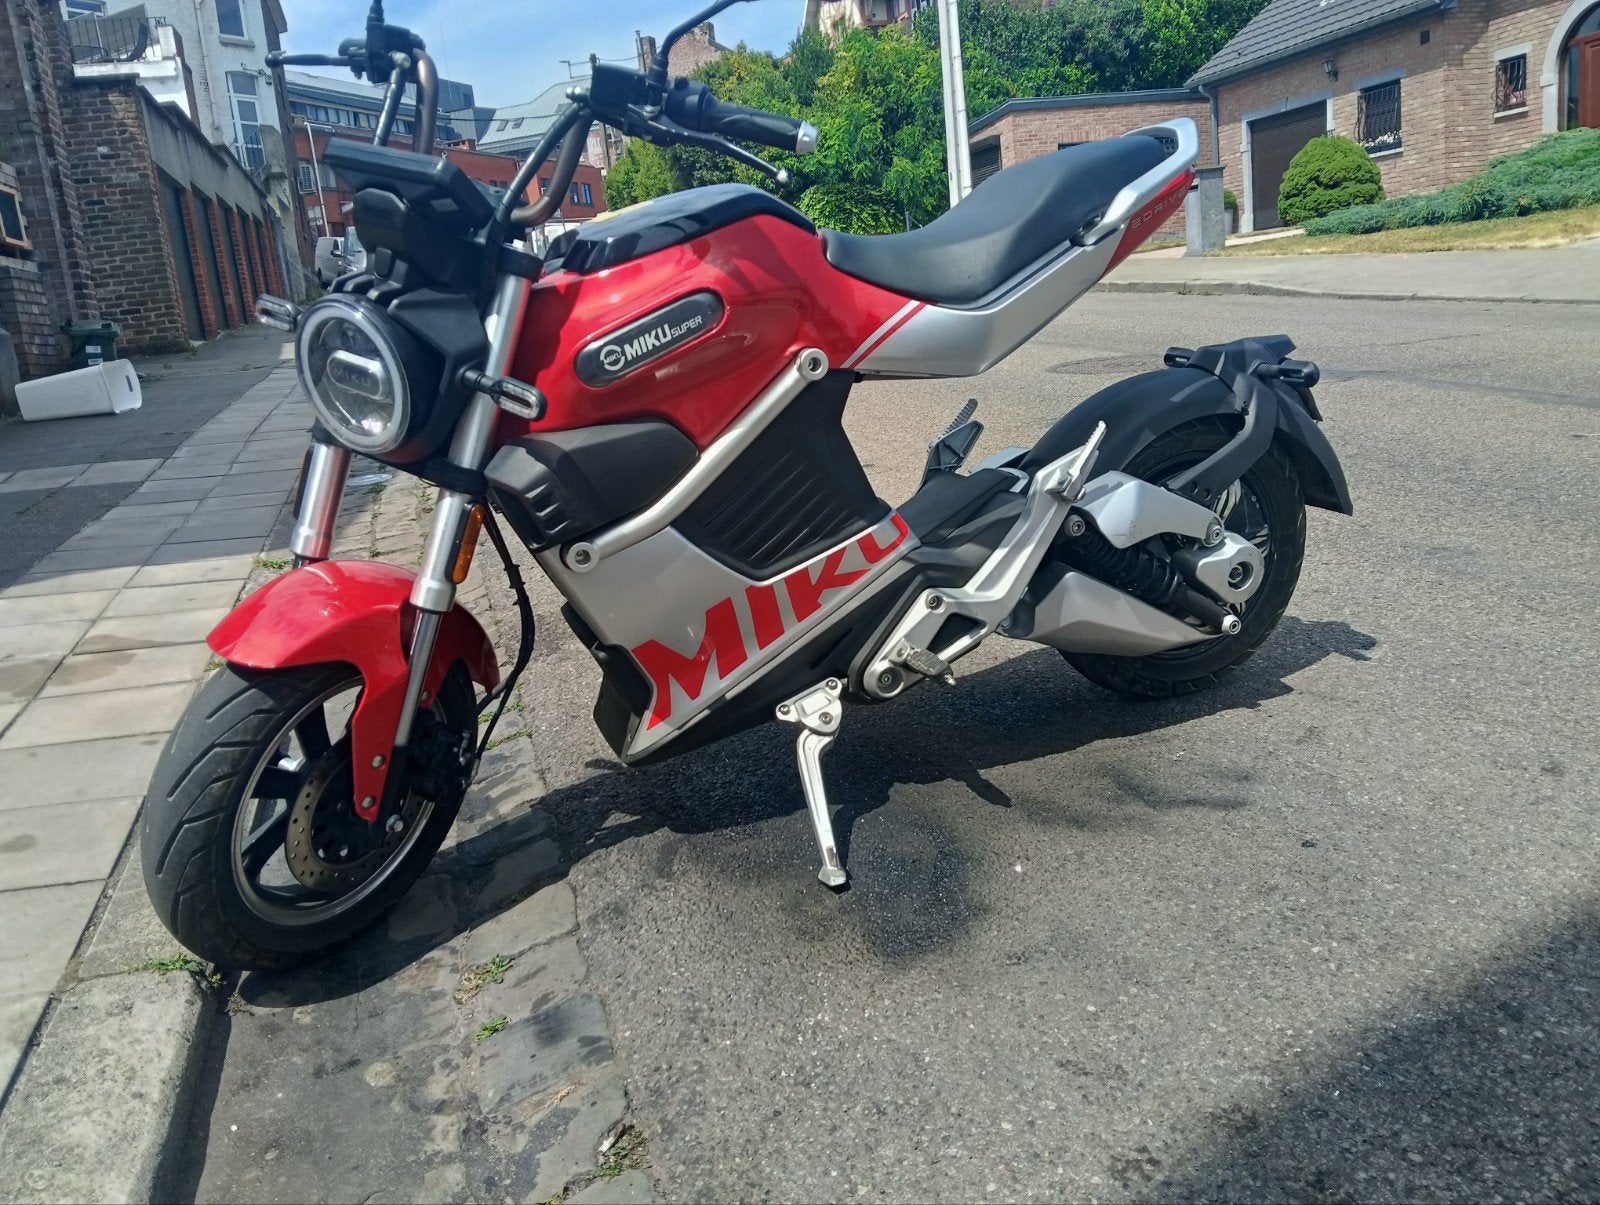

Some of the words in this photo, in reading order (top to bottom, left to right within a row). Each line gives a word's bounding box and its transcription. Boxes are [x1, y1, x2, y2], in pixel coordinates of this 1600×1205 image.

[624, 323, 672, 361] MIKU
[671, 315, 702, 338] SUPER
[630, 512, 909, 731] MIKU
